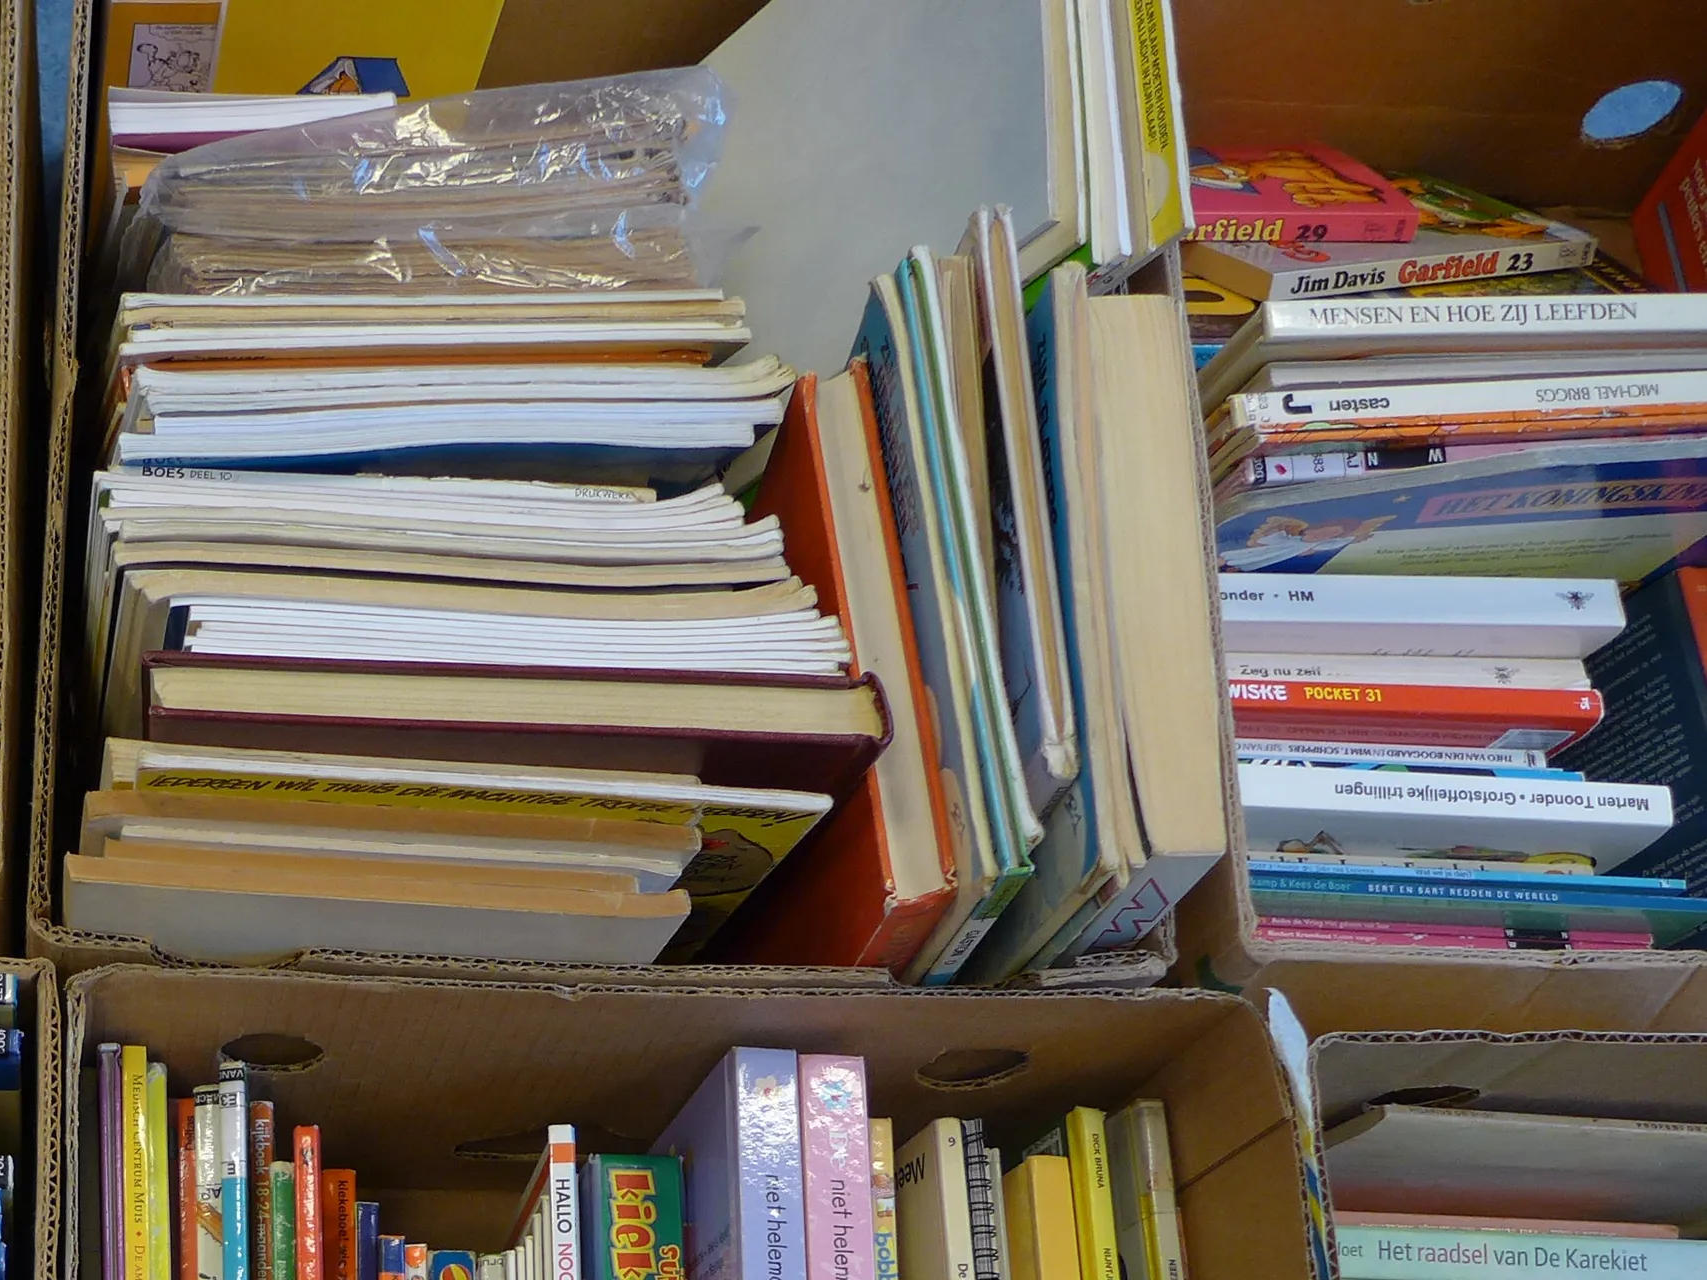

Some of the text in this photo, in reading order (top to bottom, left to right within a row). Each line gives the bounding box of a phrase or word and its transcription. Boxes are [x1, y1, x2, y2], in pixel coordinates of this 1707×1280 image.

[1295, 224, 1327, 242] 29
[1291, 252, 1533, 294] Jim Davis Garfield 23
[1310, 302, 1638, 326] MENSEN HOE ZIJ LEEFDEN
[1536, 383, 1659, 402] MICHAEL BRIGGS
[141, 467, 216, 480] BOES DEEL
[1304, 686, 1362, 702] POCKET
[146, 773, 394, 795] IEDEREEN WIL THUIS
[1334, 783, 1649, 810] Marten Toonder Grofstoffelijke trillingen
[1368, 884, 1558, 902] BERT REDDEN WERELD
[555, 1178, 572, 1234] HALLO
[1378, 1240, 1648, 1273] Het raadsel van De Karekiet
